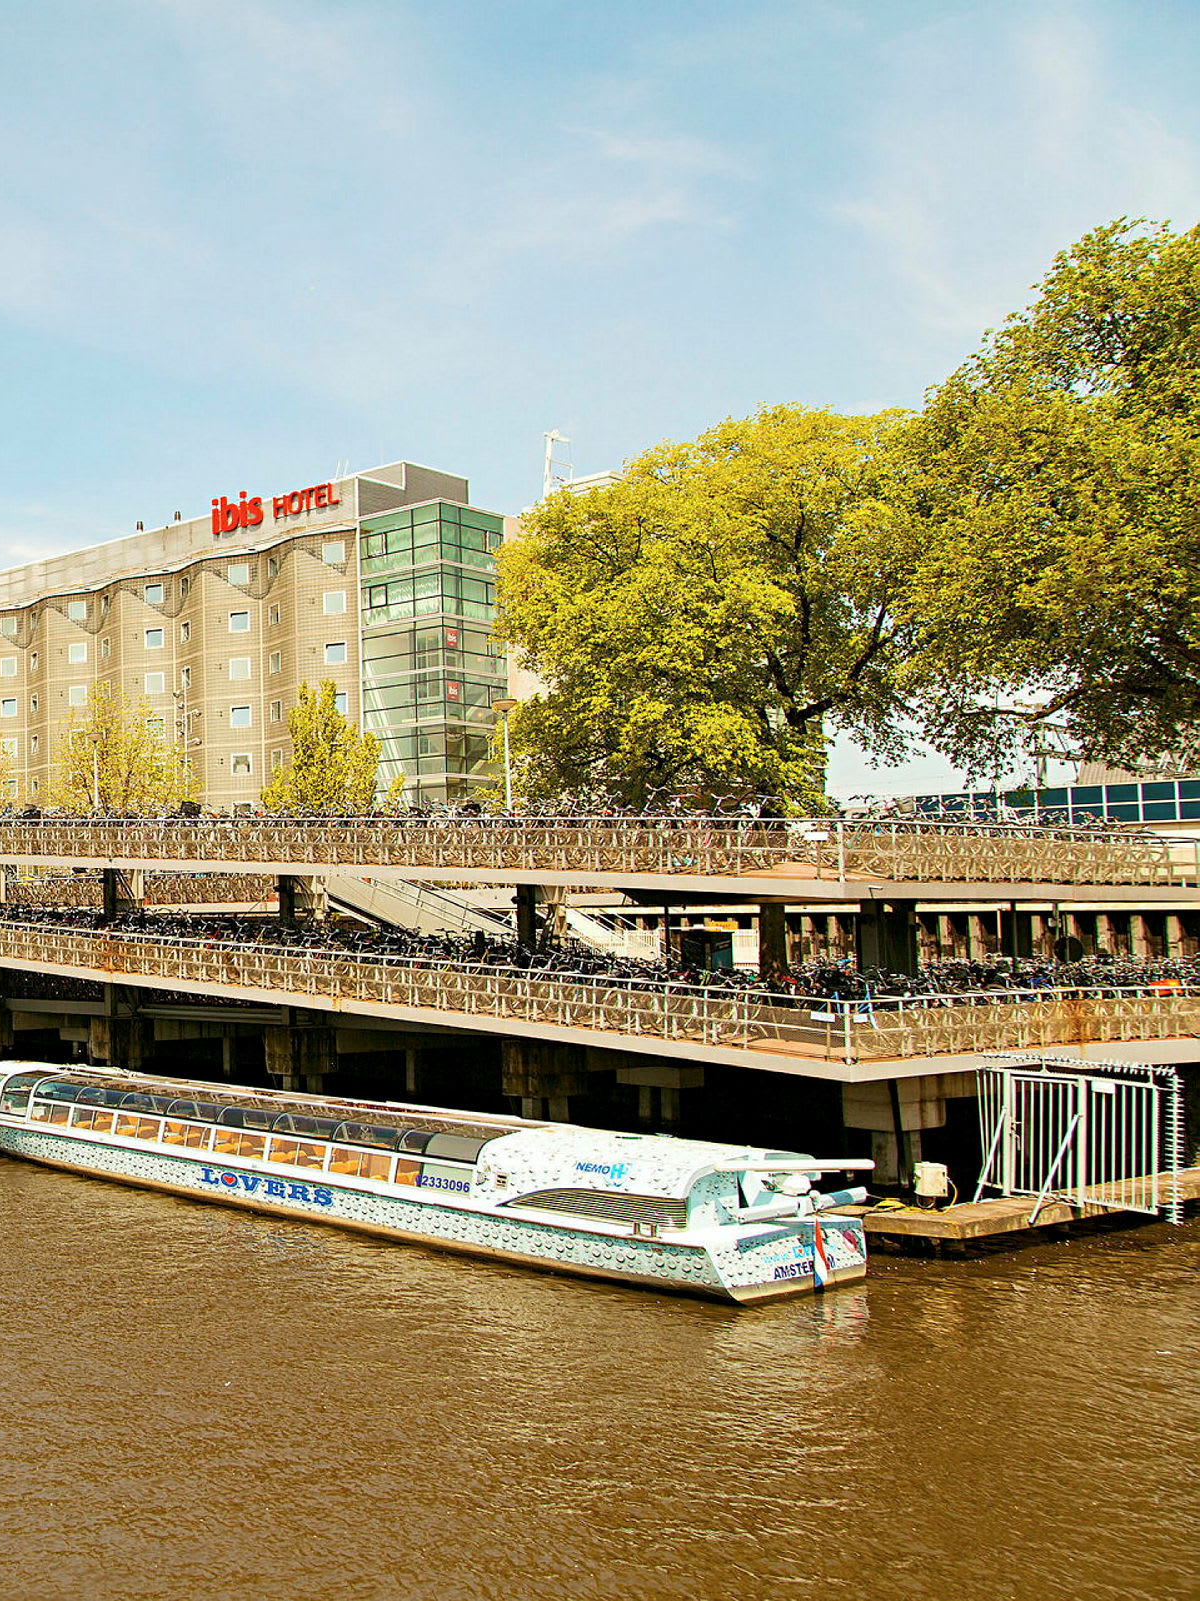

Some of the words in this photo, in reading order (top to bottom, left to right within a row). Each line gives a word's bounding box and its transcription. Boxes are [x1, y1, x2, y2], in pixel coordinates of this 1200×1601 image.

[211, 491, 264, 535] ibis
[272, 483, 341, 519] HOTEL
[201, 1167, 334, 1207] LOVERS
[576, 1162, 610, 1174] NEMO
